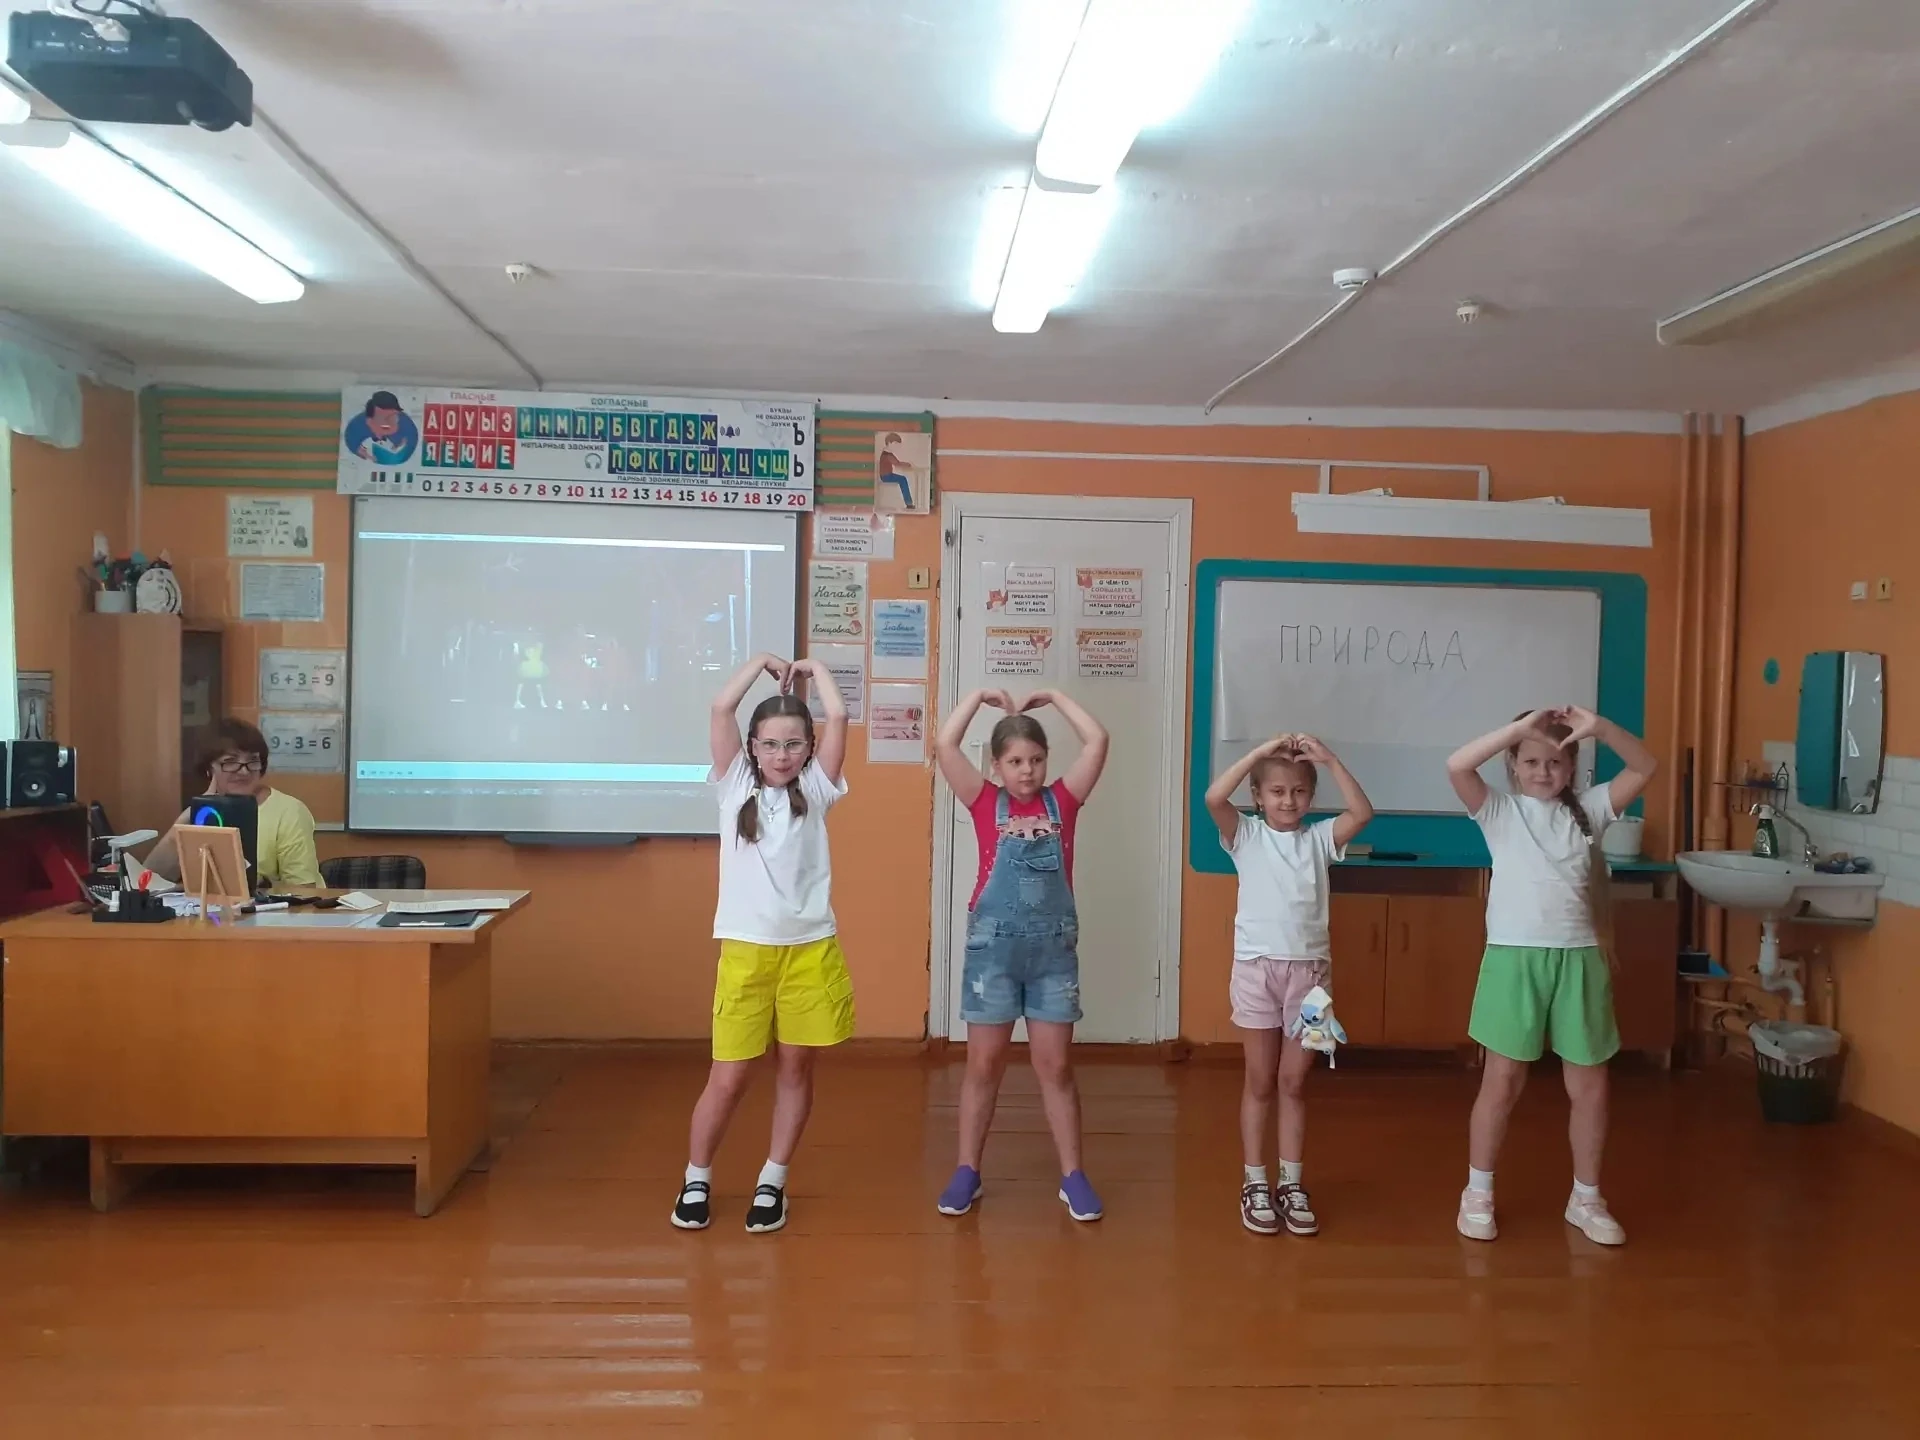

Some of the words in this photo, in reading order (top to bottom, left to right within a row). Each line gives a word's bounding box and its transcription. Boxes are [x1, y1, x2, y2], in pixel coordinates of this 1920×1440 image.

[450, 391, 497, 401] ГЛАСНЫЕ
[590, 398, 648, 407] СОГЛАСНЫЕ
[793, 423, 805, 446] Ъ
[521, 442, 566, 450] НЕПАРНЫЕ
[567, 443, 605, 452] ЗВОНКИЕ
[794, 454, 804, 478] Ь
[721, 480, 760, 488] НЕПАРНЫЕ
[422, 480, 432, 492] 0
[437, 481, 444, 492] 1
[450, 481, 460, 493] 2
[464, 481, 473, 493] 3
[479, 482, 489, 493] 4
[493, 483, 503, 494] 5
[508, 483, 517, 495] 6
[524, 484, 532, 495] 7
[537, 484, 546, 496] 8
[552, 485, 561, 496] 9
[567, 485, 584, 497] 10
[589, 486, 604, 498] 11
[611, 487, 628, 499] 12
[633, 488, 650, 500] 13
[655, 489, 673, 501] 14
[678, 490, 695, 502] 15
[701, 491, 718, 503] 16
[723, 492, 739, 503] 17
[744, 493, 761, 504] 18
[766, 494, 783, 505] 19
[787, 494, 806, 506] 20
[814, 586, 857, 598] Начало
[1279, 623, 1468, 674] ПРИРОДА
[270, 672, 280, 685] 6
[298, 673, 307, 686] 3
[325, 673, 334, 687] 9
[270, 735, 280, 749] 9
[295, 736, 304, 749] 3
[322, 736, 332, 750] 6
